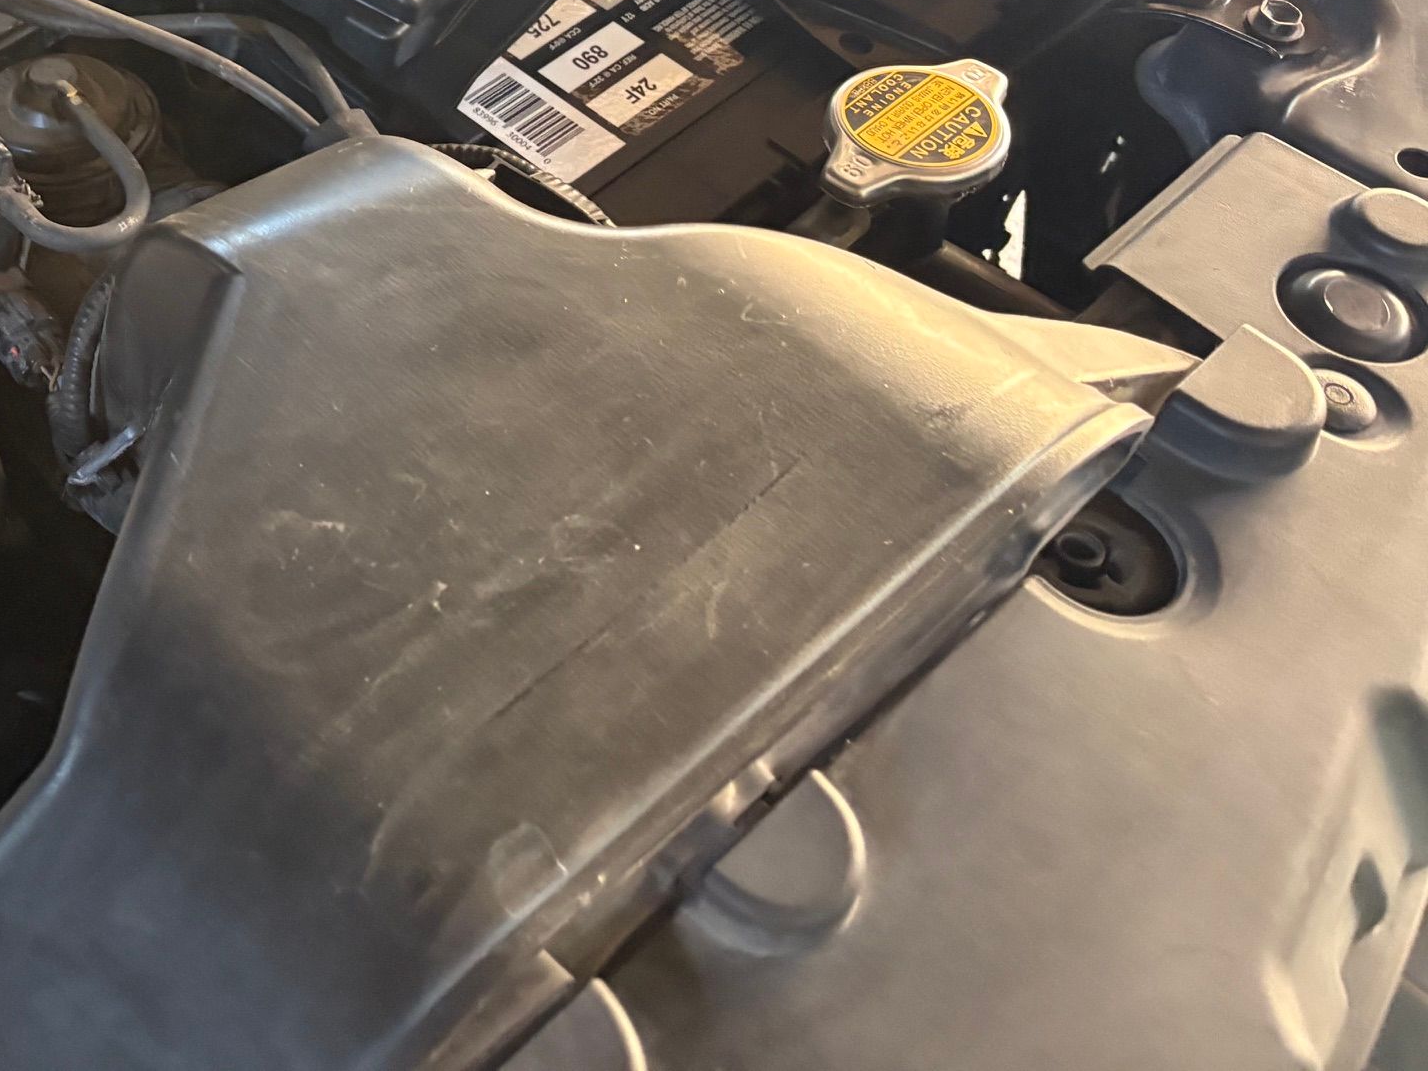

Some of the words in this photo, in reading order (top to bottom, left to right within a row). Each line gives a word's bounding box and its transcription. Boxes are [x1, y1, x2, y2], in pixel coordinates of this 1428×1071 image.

[527, 14, 561, 39] 725
[572, 45, 609, 71] 890
[624, 77, 658, 105] 24F
[851, 73, 904, 114] COOLANT
[863, 79, 913, 117] ENGINE
[909, 107, 982, 159] CAUTION
